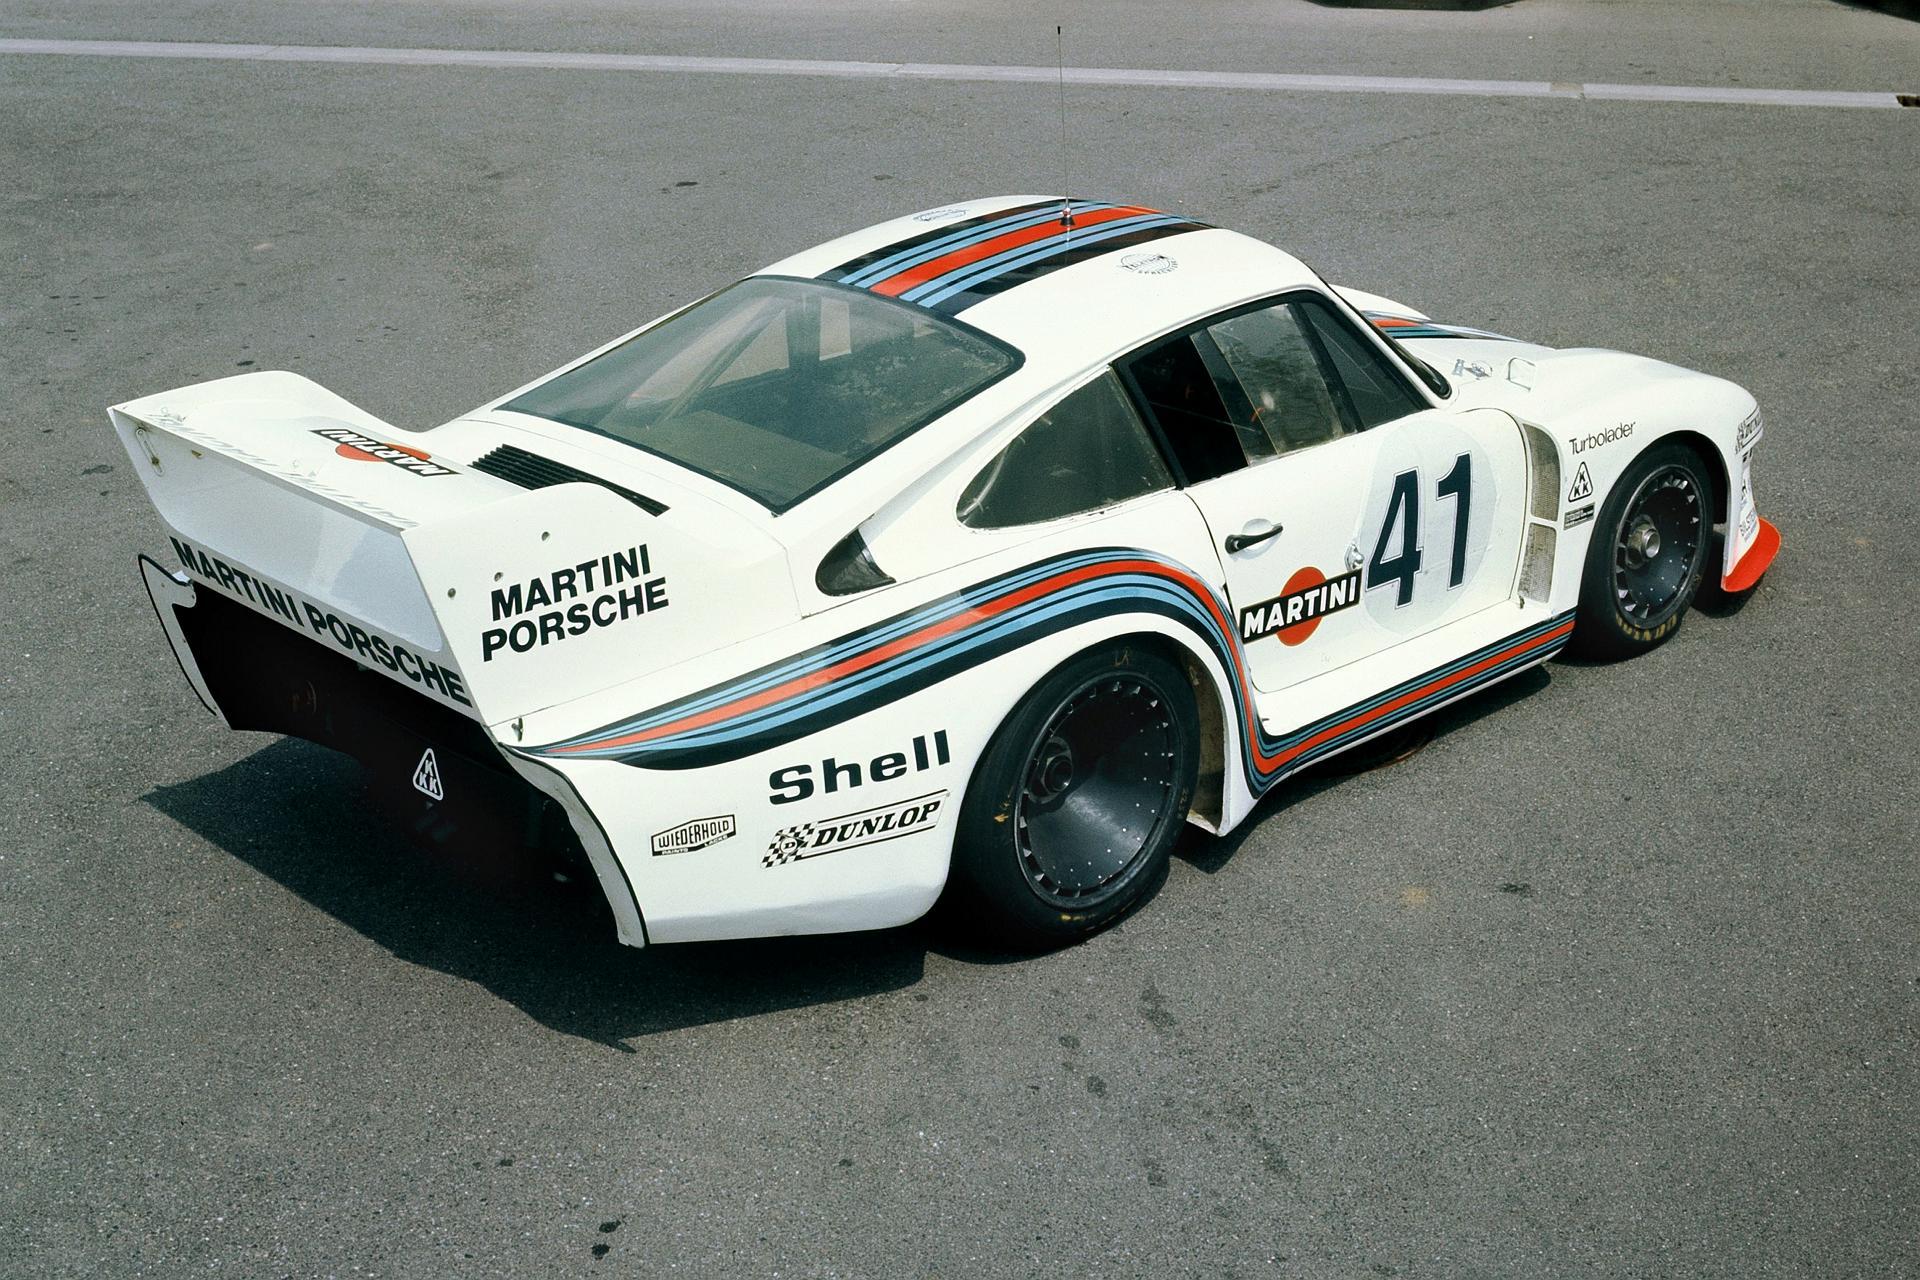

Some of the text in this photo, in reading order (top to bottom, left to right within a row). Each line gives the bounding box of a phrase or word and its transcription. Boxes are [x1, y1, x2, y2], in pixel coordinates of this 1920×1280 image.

[319, 430, 451, 475] MARTINI
[1568, 421, 1637, 455] Turbolader
[1366, 450, 1472, 609] 41
[490, 544, 652, 622] MARTINI
[1243, 576, 1357, 639] MARTINI
[169, 535, 474, 708] MARTINI PORSCHE
[481, 577, 670, 662] PORSCHE
[768, 729, 951, 806] Shell
[658, 819, 730, 848] WIEDERHOLD
[811, 800, 942, 848] DUNLOP
